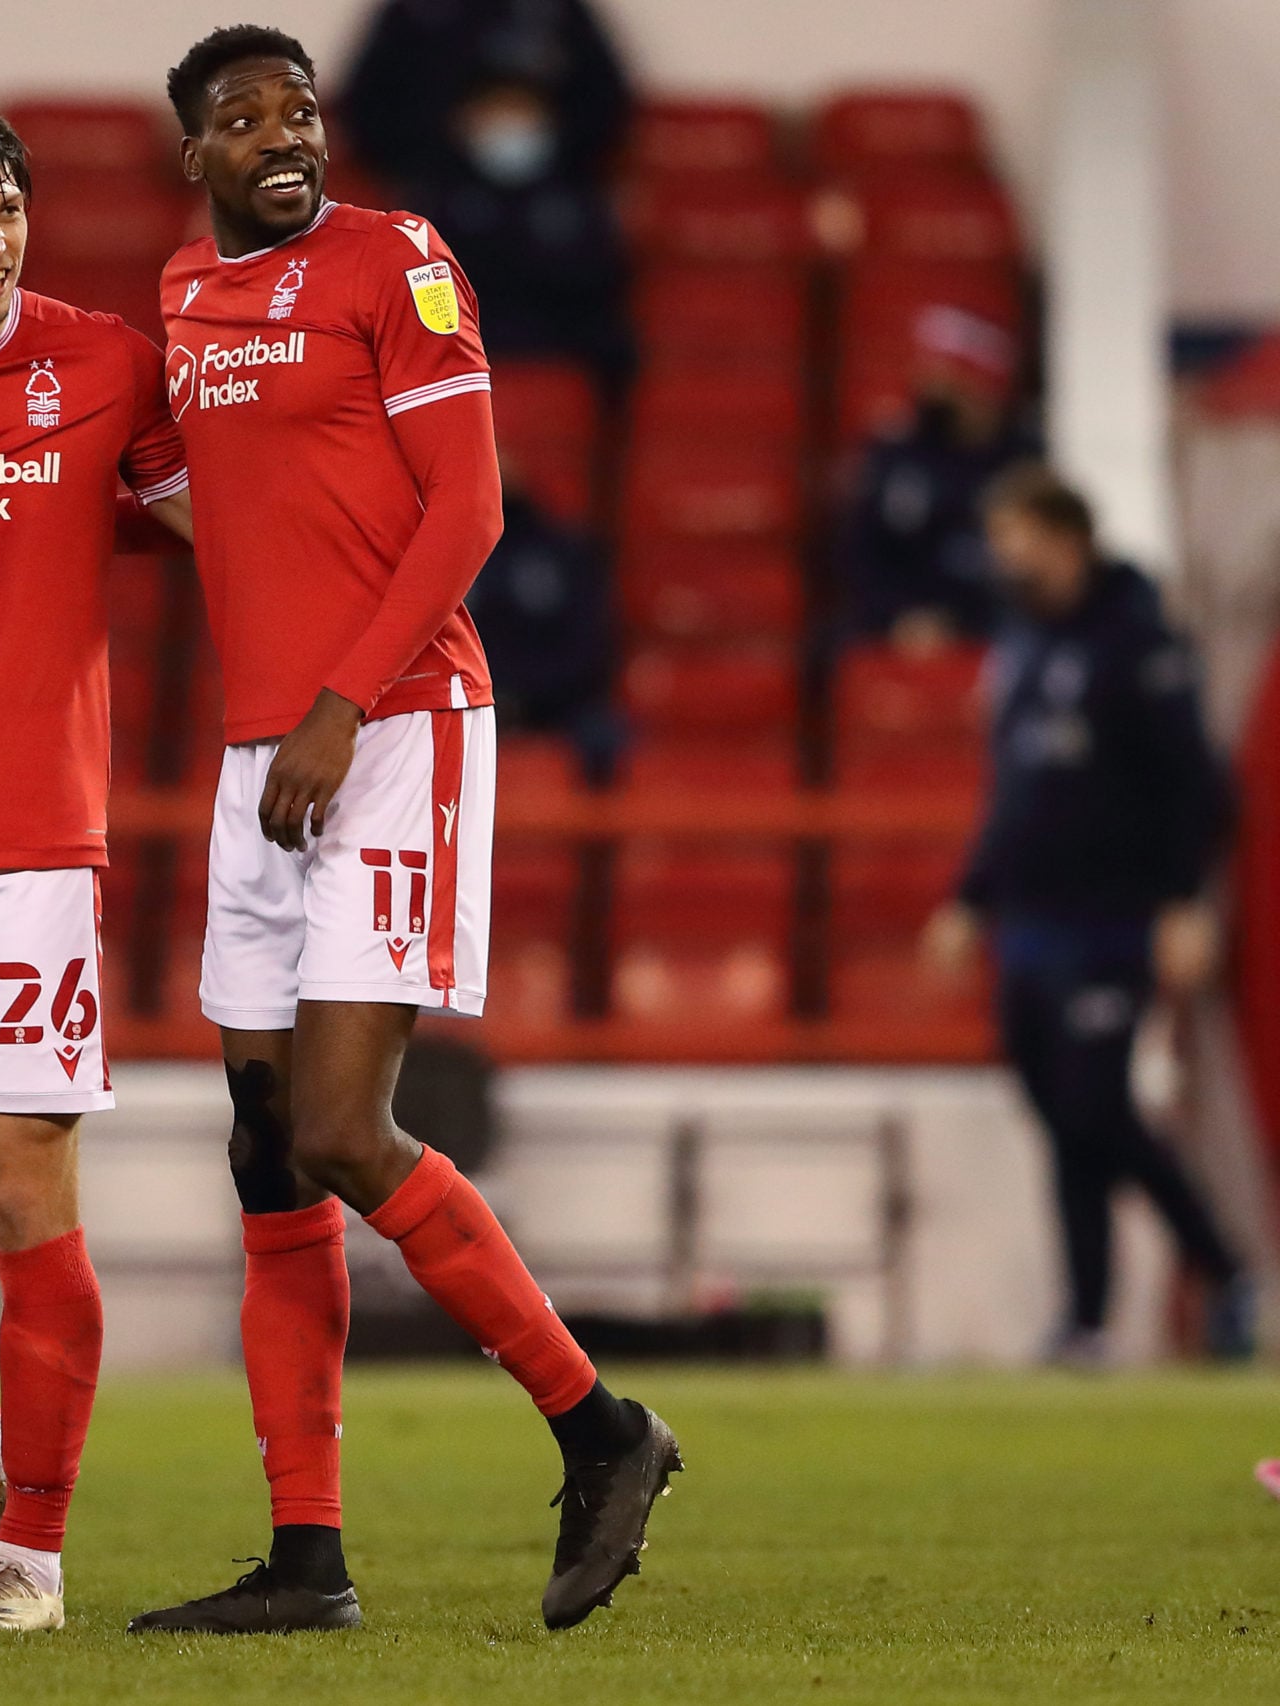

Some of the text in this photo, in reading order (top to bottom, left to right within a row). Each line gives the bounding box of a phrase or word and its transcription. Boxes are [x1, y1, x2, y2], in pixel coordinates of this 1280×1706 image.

[412, 271, 430, 283] sky
[200, 332, 306, 374] Football
[199, 374, 260, 410] Index
[360, 848, 427, 934] 11
